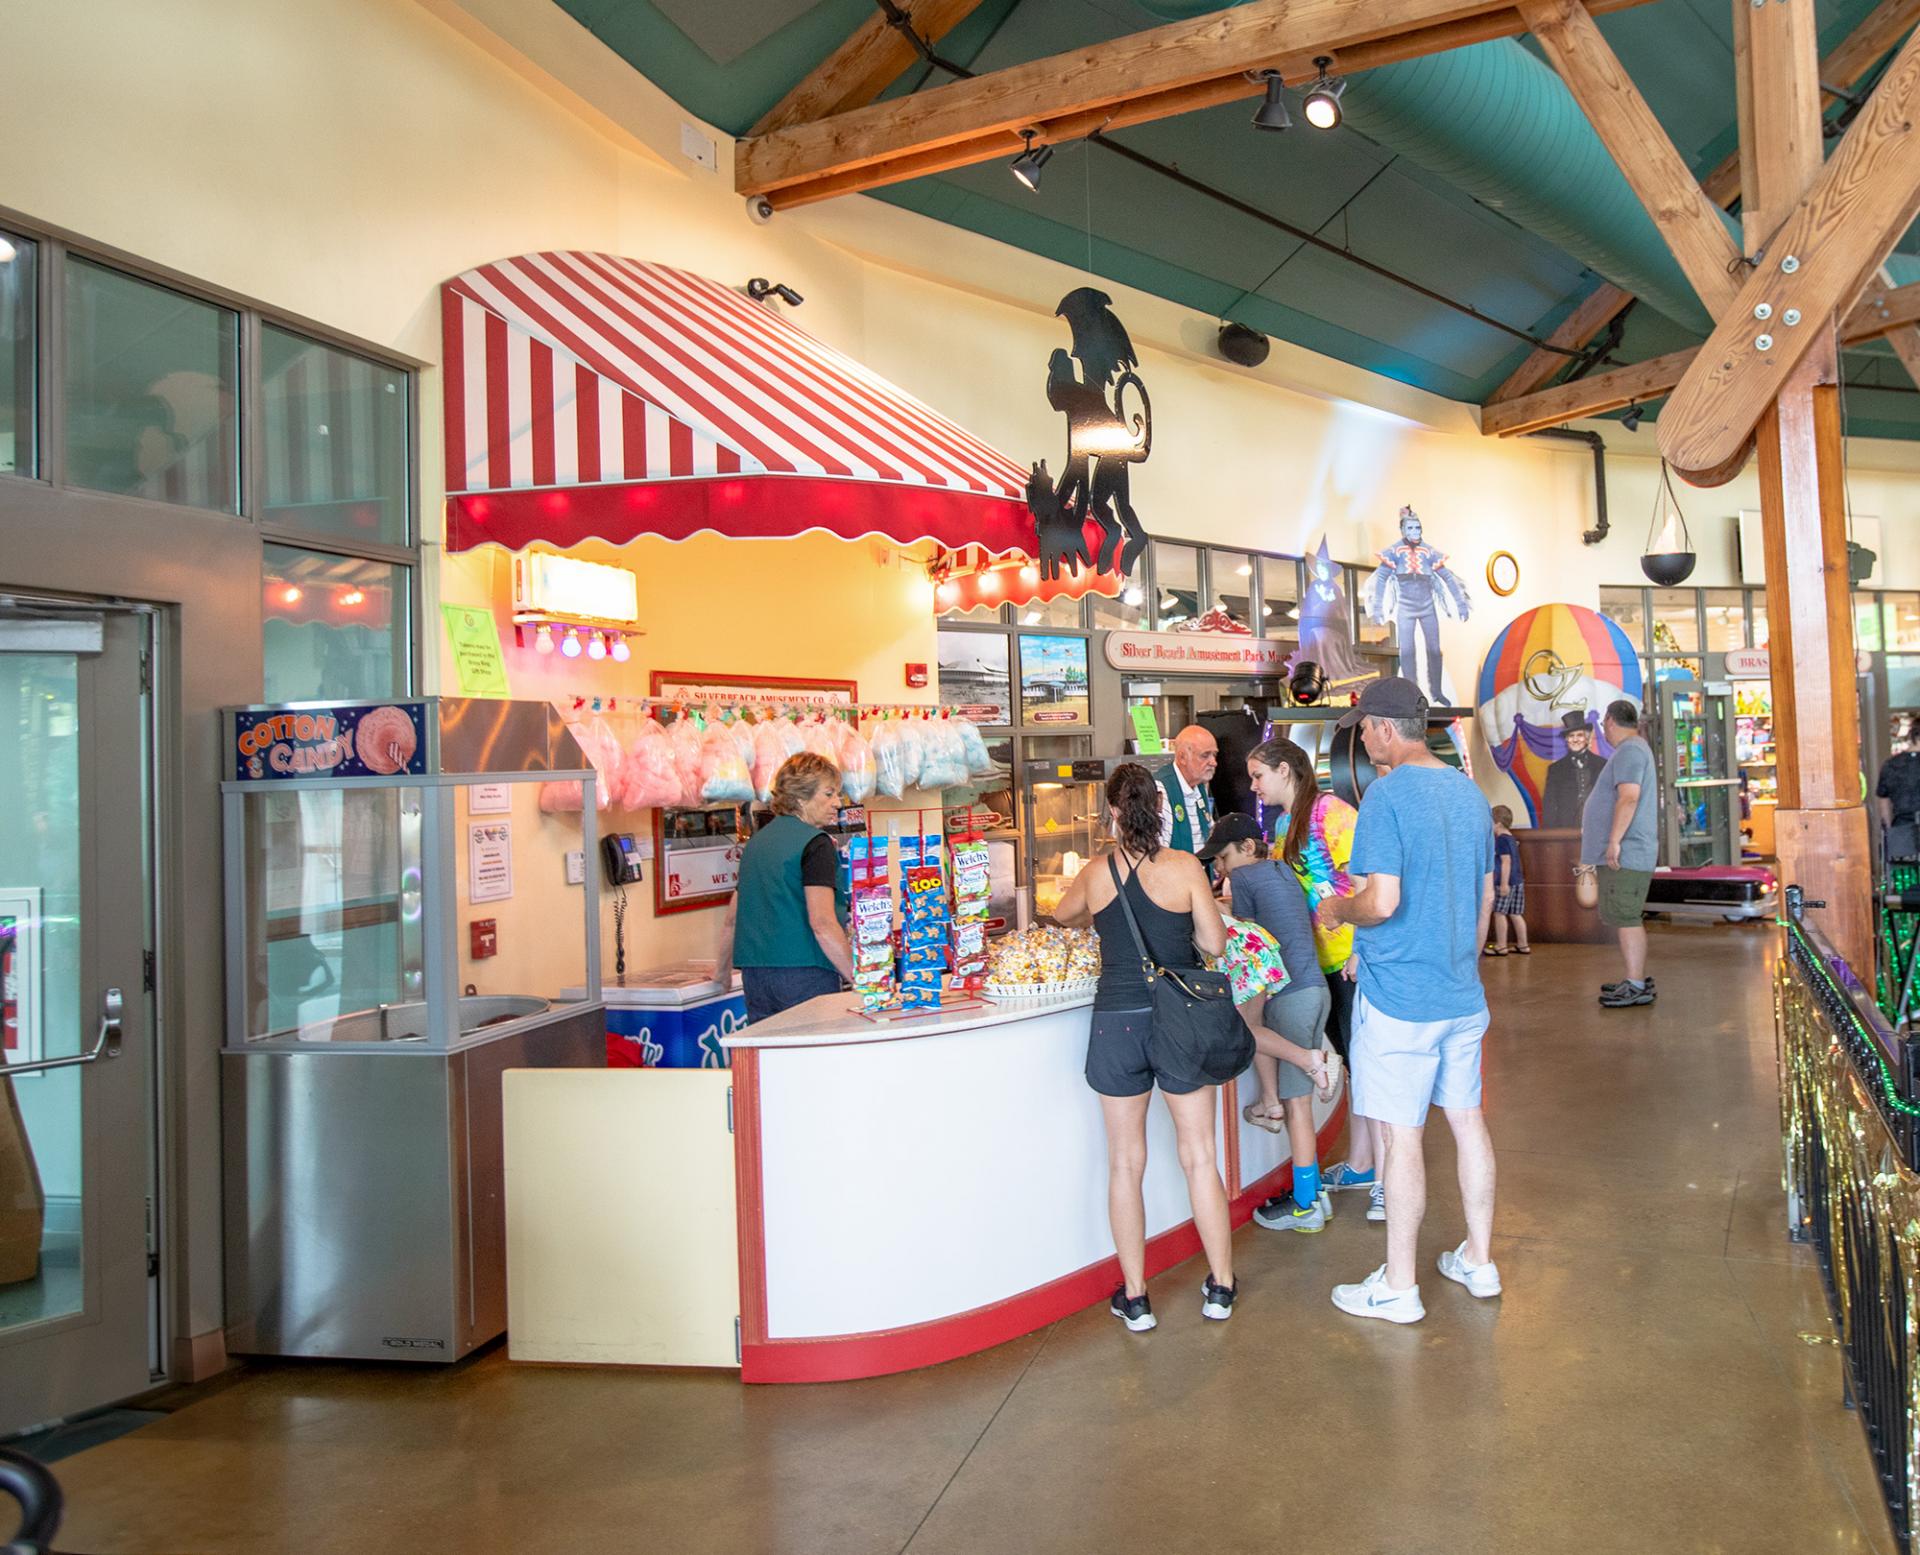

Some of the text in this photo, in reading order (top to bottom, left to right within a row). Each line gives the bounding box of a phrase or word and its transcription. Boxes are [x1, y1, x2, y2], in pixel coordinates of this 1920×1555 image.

[1122, 642, 1152, 657] Silver
[1154, 645, 1185, 659] Beach
[1188, 646, 1241, 661] Amusement
[1244, 649, 1265, 662] Park
[1739, 657, 1768, 667] BRAS
[238, 714, 336, 756] COTTON
[269, 728, 355, 773] CANDY
[957, 852, 988, 865] Welch's
[712, 873, 729, 884] WE
[911, 878, 942, 893] ZOO
[858, 900, 892, 913] Welch's
